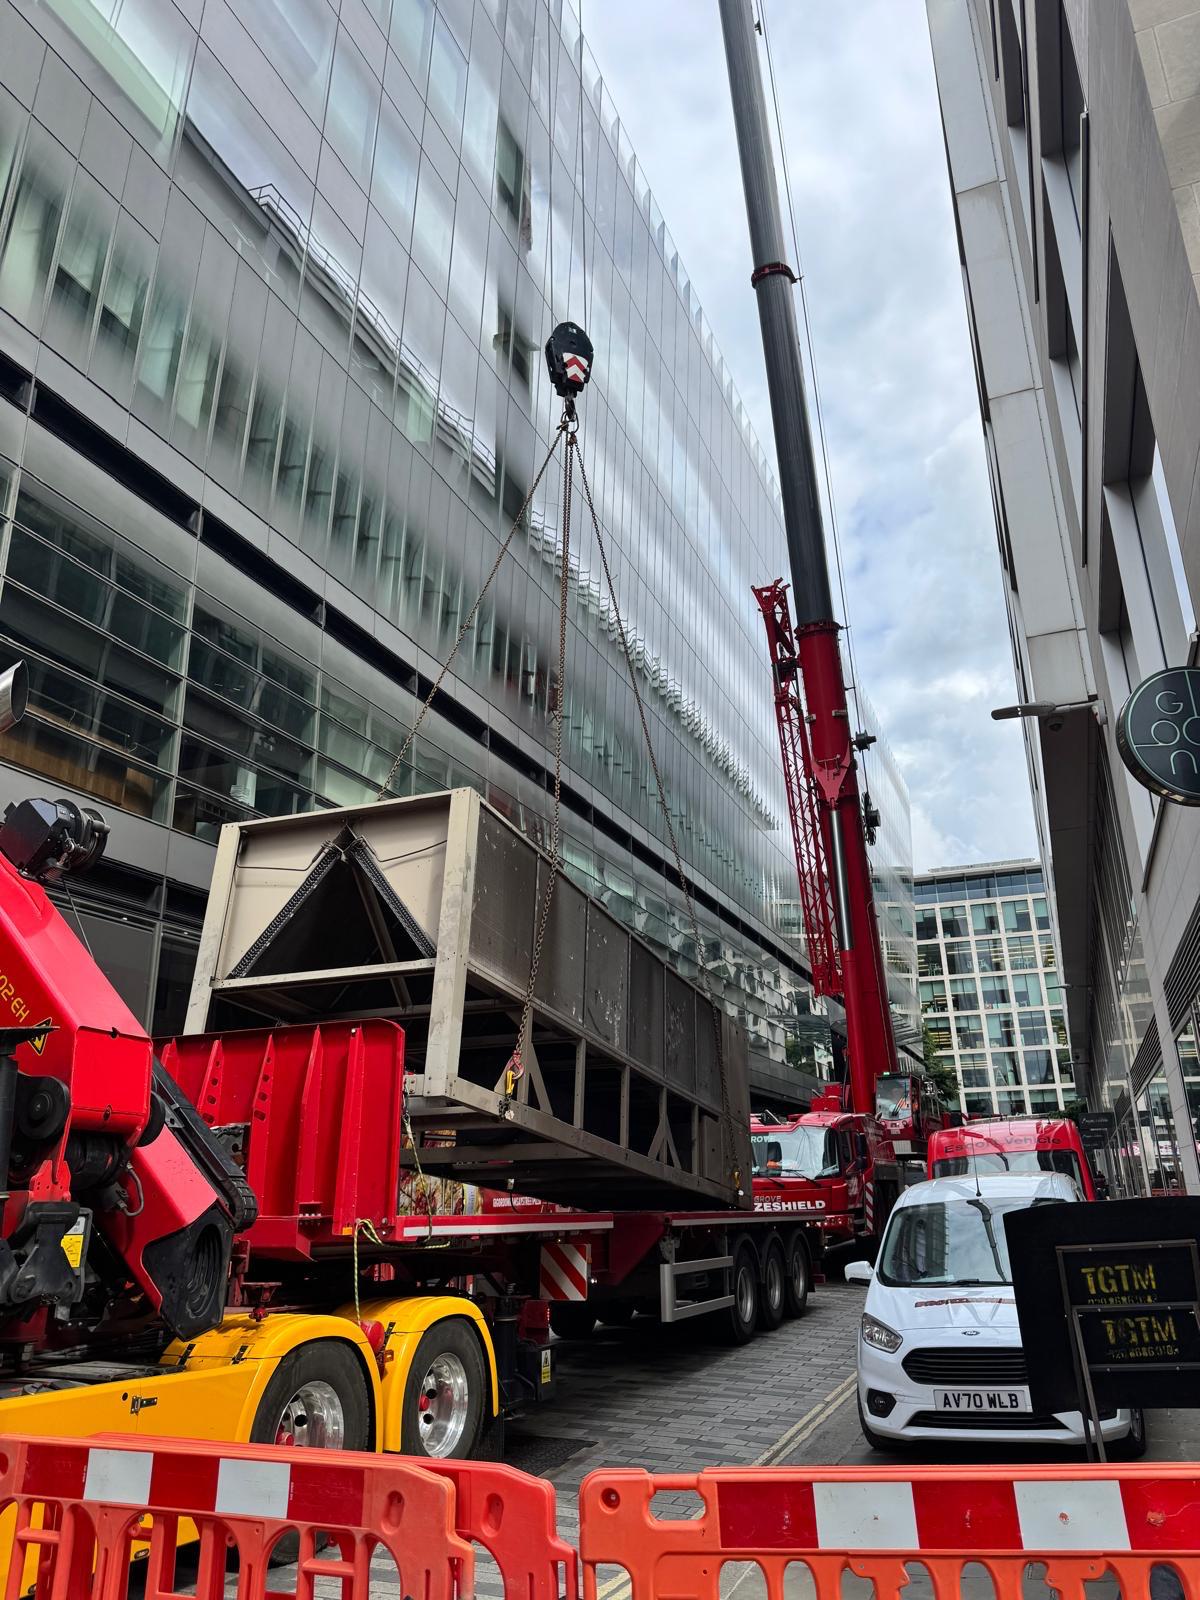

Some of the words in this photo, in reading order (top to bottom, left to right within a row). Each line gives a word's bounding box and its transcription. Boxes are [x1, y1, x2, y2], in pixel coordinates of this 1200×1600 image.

[1081, 1264, 1156, 1295] TGTM
[1102, 1316, 1177, 1345] TGTM
[943, 1392, 983, 1409] AV70
[986, 1392, 1019, 1409] WLB
